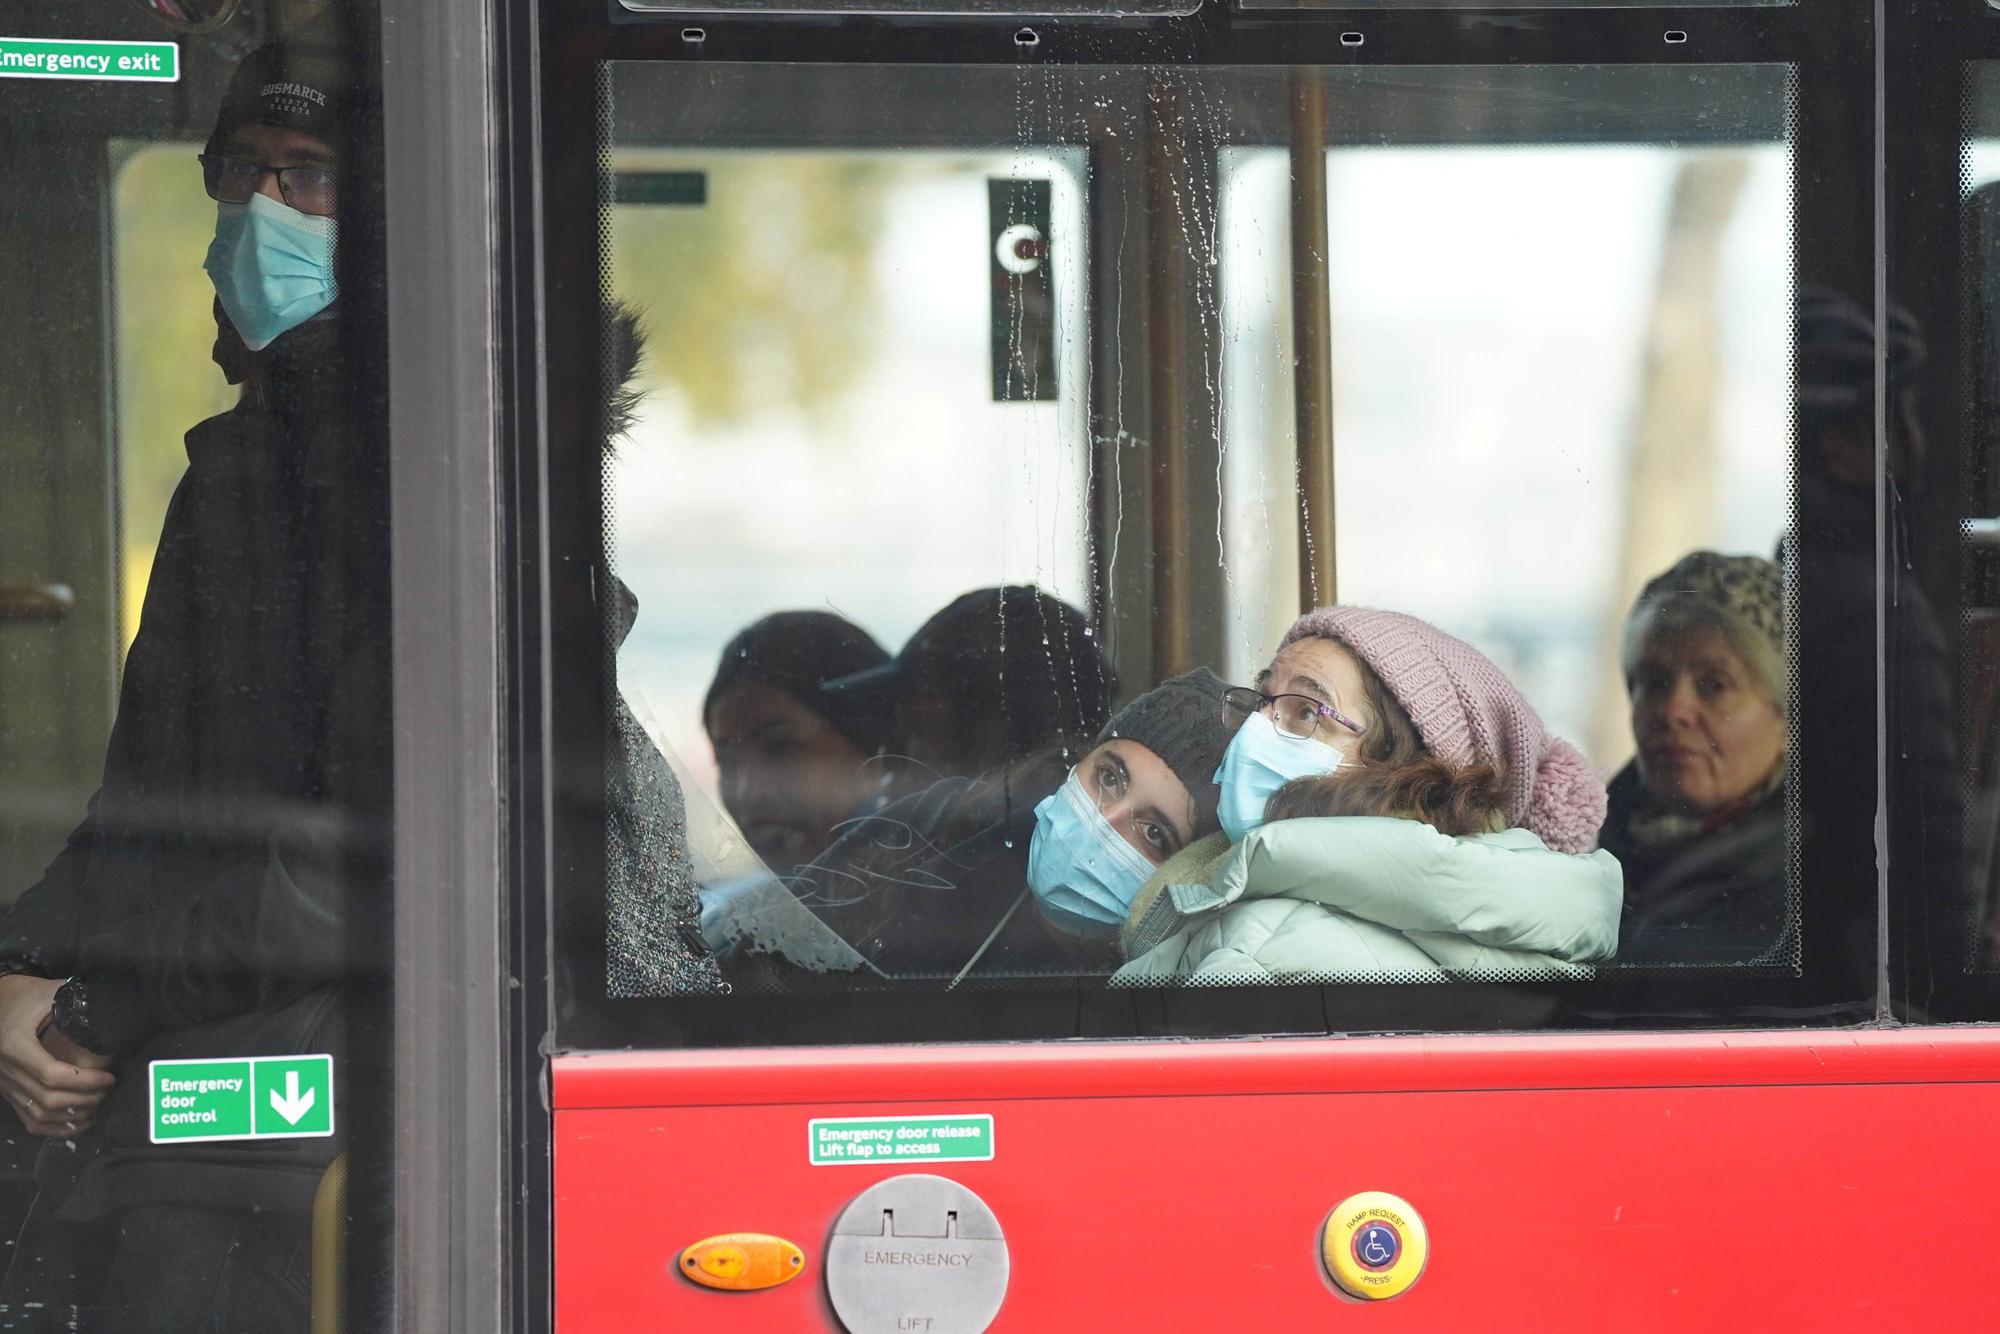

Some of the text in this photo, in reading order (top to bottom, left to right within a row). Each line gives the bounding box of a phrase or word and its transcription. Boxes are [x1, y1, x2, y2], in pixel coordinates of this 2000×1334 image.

[0, 48, 161, 73] mergency exit
[261, 83, 327, 106] BISMARCK
[161, 1078, 243, 1094] Emergency
[161, 1095, 196, 1108] door
[161, 1109, 217, 1124] control
[819, 1125, 981, 1143] Emergency door release
[820, 1142, 941, 1158] Lift flap to access
[1346, 1208, 1406, 1229] RAMP REQUEST
[864, 1251, 973, 1266] EMERGENCY
[897, 1318, 933, 1331] LIFT
